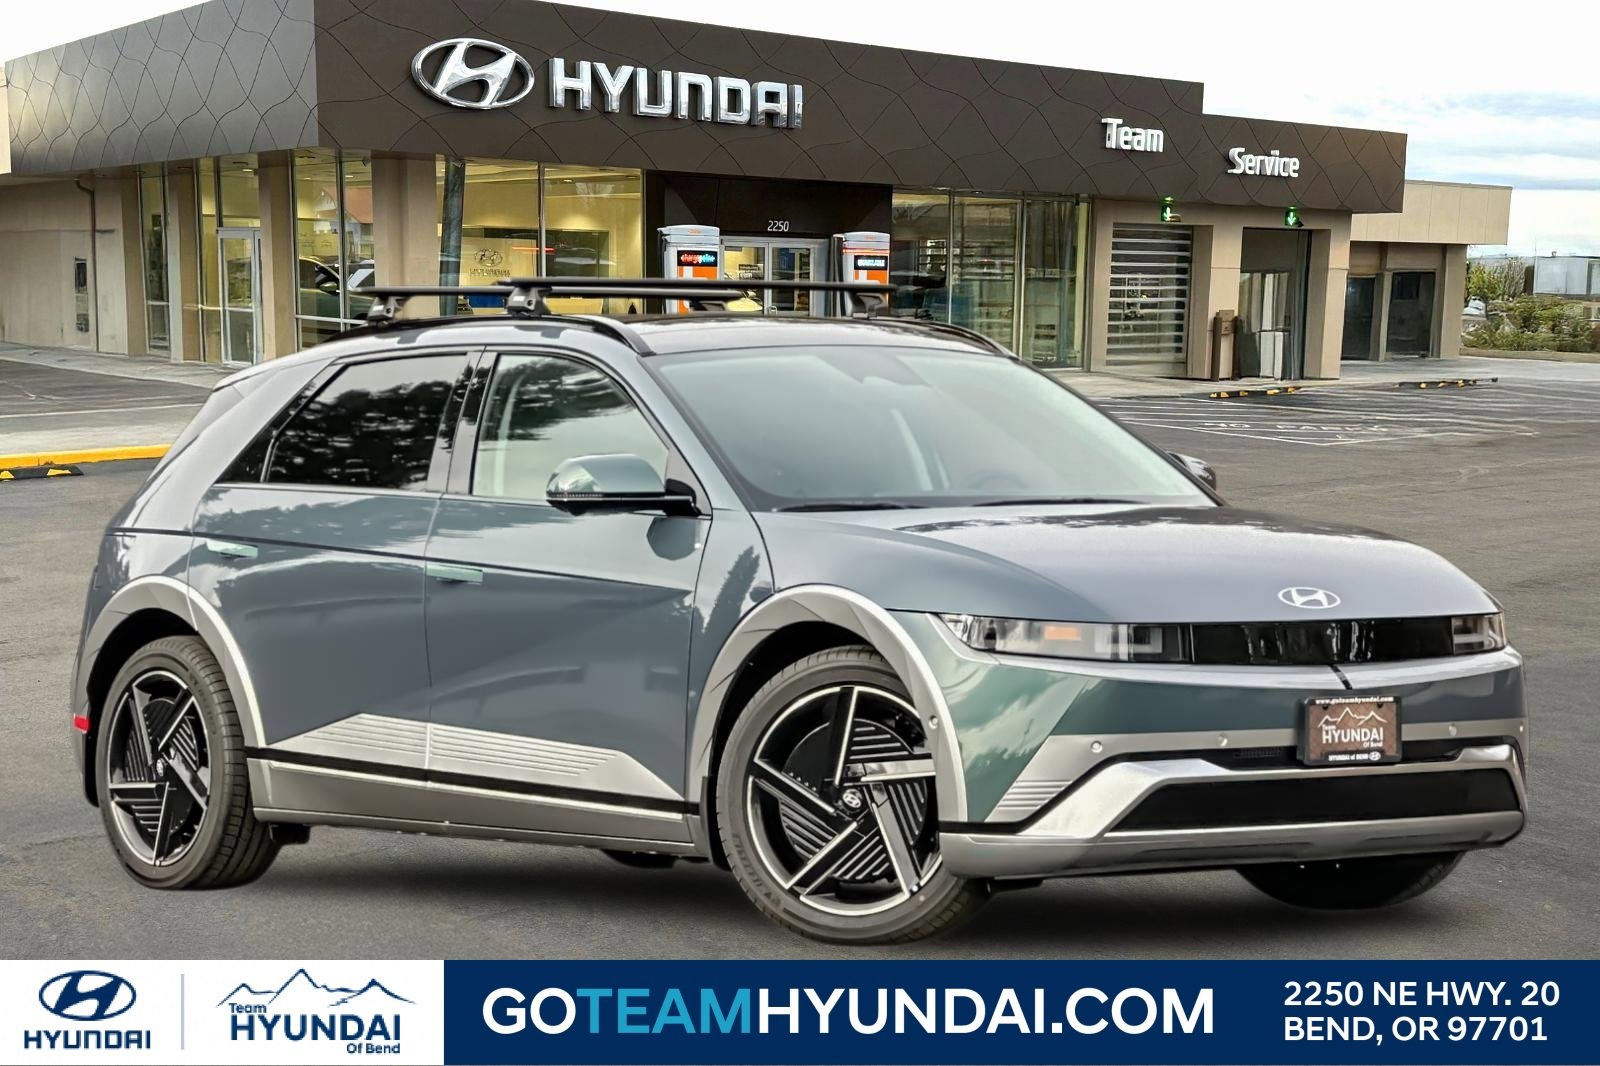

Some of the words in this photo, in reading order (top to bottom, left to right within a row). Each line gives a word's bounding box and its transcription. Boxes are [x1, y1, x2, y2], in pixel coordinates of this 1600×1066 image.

[549, 57, 804, 129] HYUNDAI
[1101, 117, 1164, 152] Team
[1227, 147, 1300, 177] Service
[767, 220, 790, 232] 2250
[1322, 727, 1384, 743] HYUNDAI
